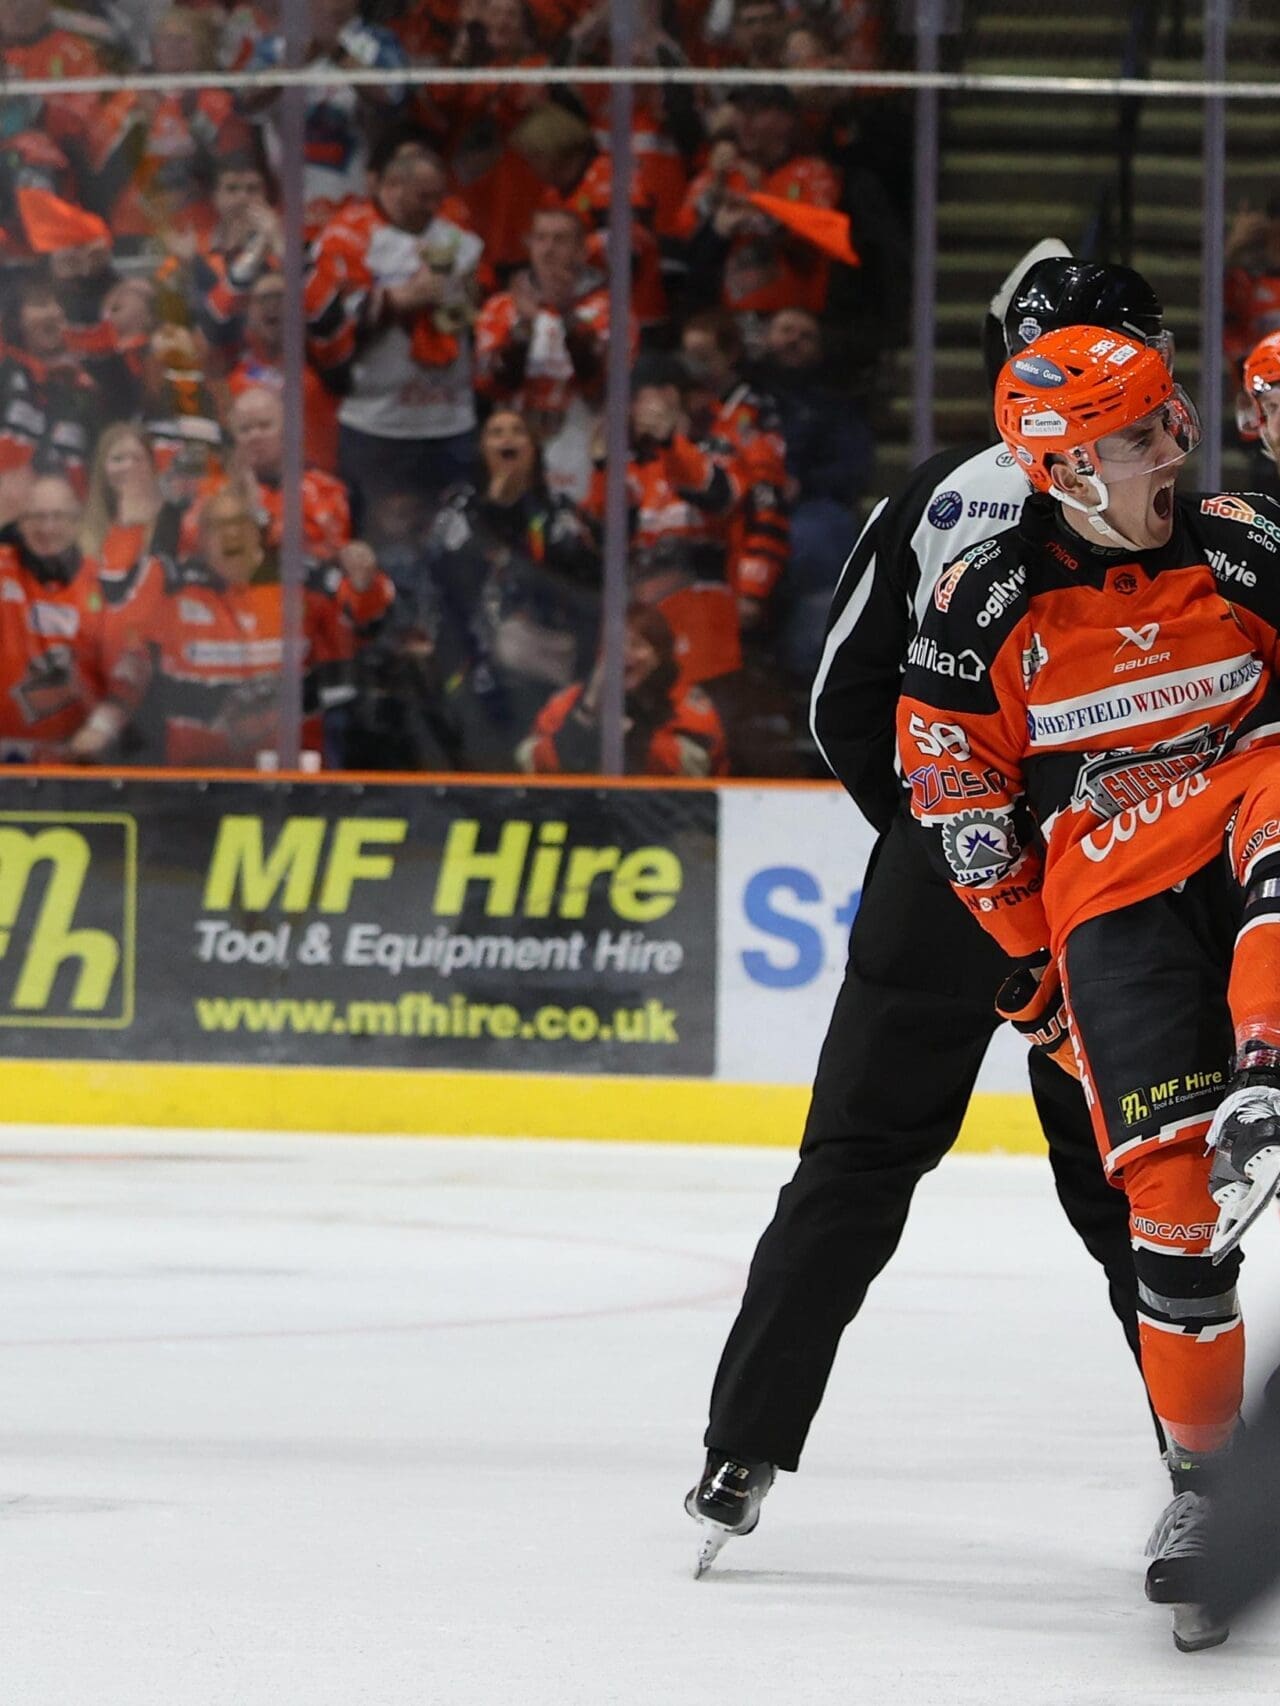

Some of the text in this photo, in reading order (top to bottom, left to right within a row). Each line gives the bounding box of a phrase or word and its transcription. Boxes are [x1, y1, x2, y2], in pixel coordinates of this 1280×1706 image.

[973, 547, 1003, 571] solar
[1203, 548, 1257, 588] ilvie
[1037, 697, 1132, 736] SHEFFIELD
[1131, 676, 1215, 713] WINDOW
[1101, 750, 1208, 810] STEELER
[204, 815, 683, 922] MF Hire
[195, 919, 684, 976] Tool & Equipment Hire
[196, 994, 678, 1044] www.mfhire.co.uk
[1150, 1071, 1222, 1103] MF Hire
